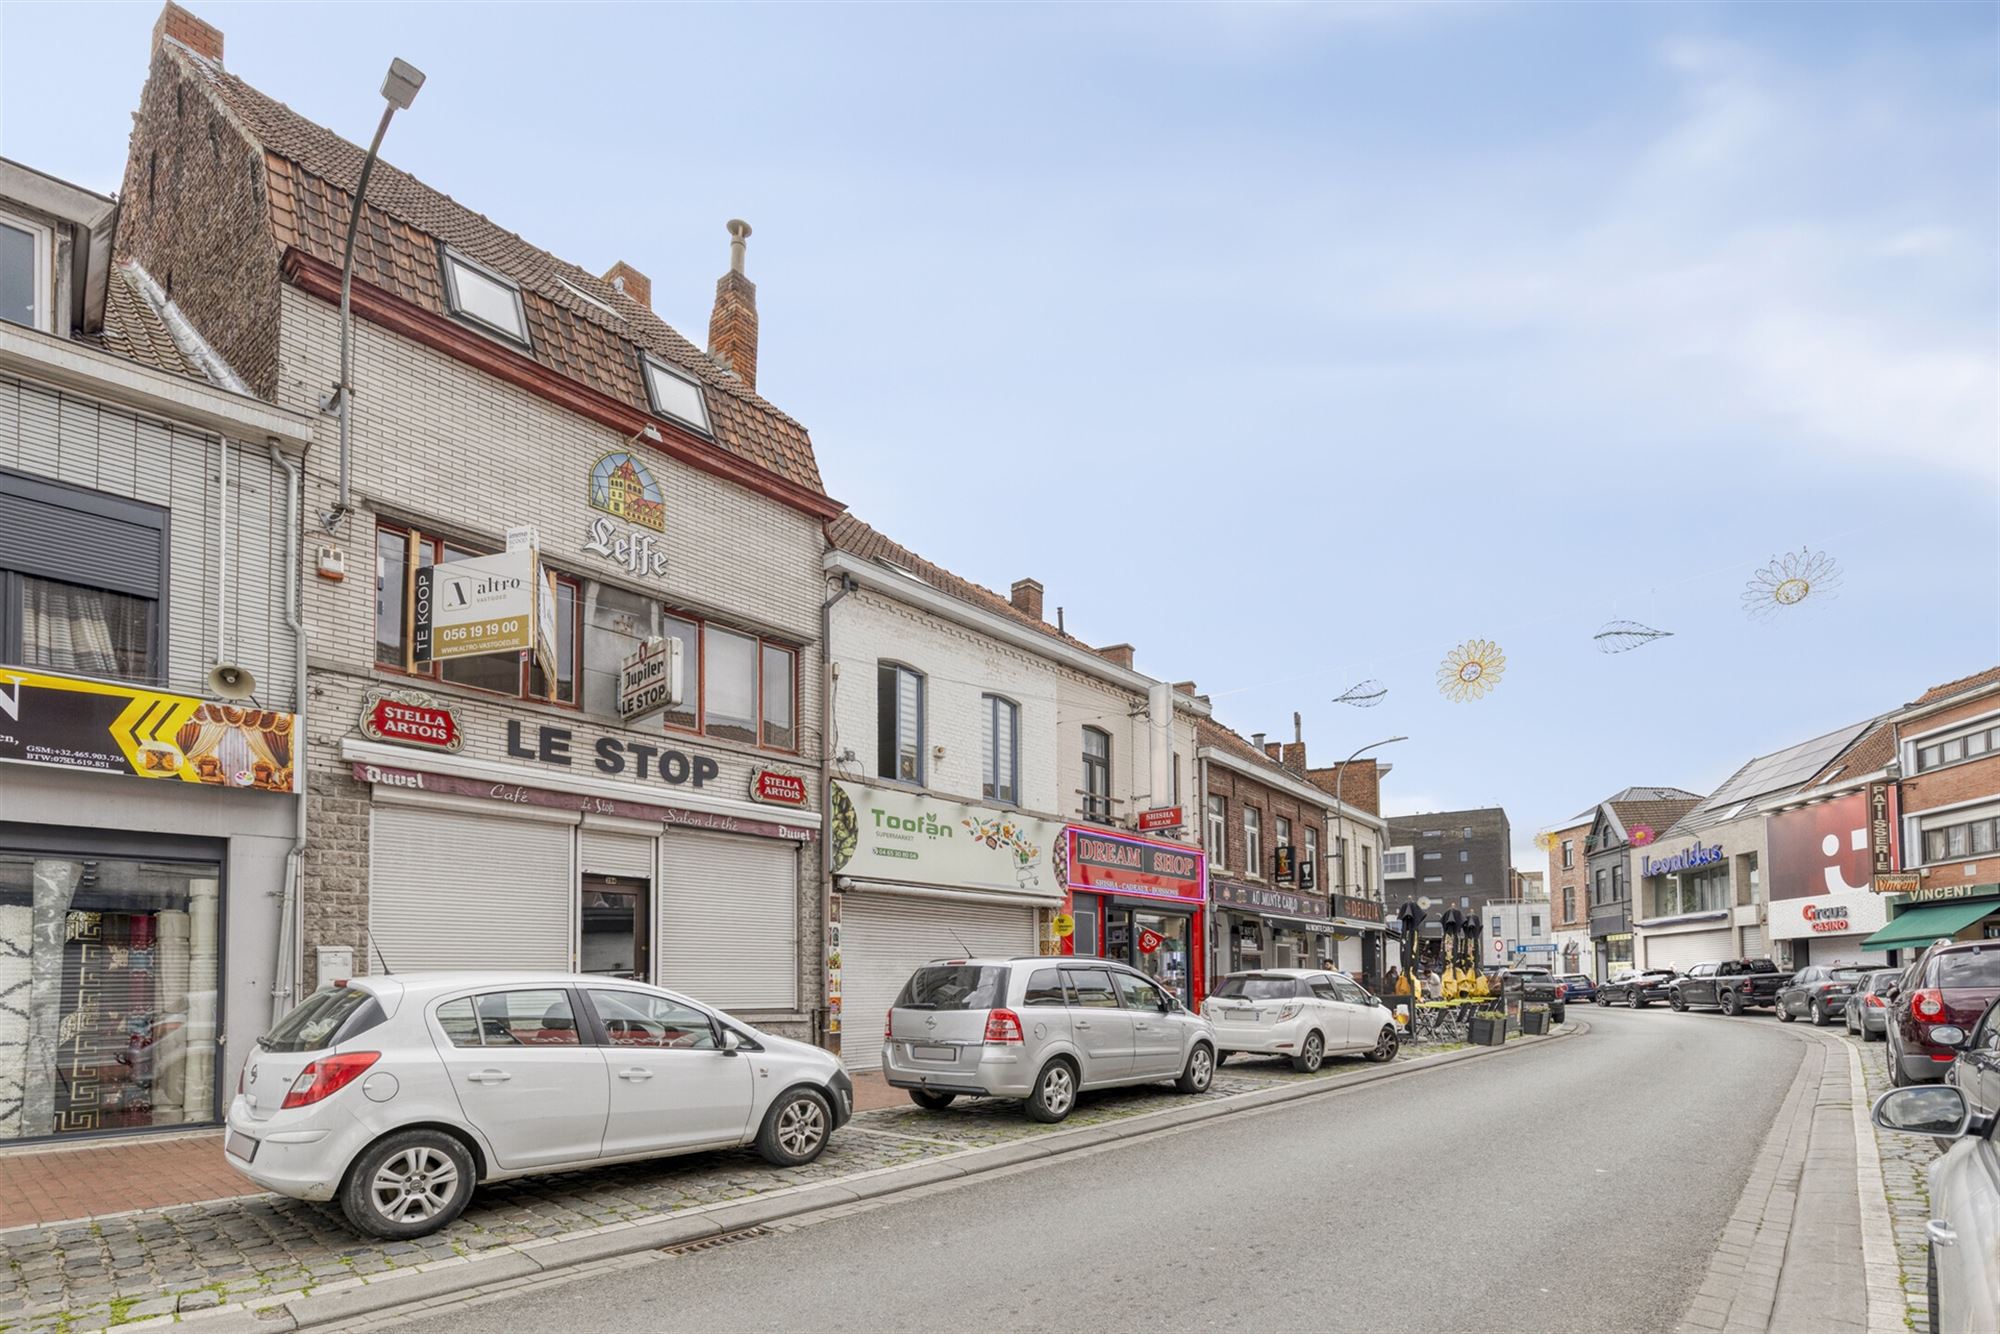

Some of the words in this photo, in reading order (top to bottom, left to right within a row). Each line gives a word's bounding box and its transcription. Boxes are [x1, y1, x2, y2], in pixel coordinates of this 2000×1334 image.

[583, 518, 668, 577] Leffe
[477, 577, 521, 594] altro
[416, 575, 430, 624] KOOP
[416, 626, 428, 653] TE
[443, 627, 467, 641] 056
[470, 625, 483, 638] 19
[486, 623, 499, 635] 19
[501, 620, 519, 633] 00
[624, 660, 664, 690] Jupiler
[622, 697, 634, 715] LE
[637, 684, 666, 709] STOP
[384, 706, 447, 727] STELLA
[384, 720, 448, 740] ARTOIS
[507, 719, 572, 766] LE
[594, 736, 720, 788] STOP
[365, 765, 424, 788] Duvel
[764, 775, 800, 790] STELLA
[489, 784, 529, 803] Café
[764, 786, 801, 800] ARTOIS
[580, 797, 592, 810] Le
[595, 798, 616, 815] Stop
[1146, 810, 1175, 820] SHISHA
[661, 808, 702, 825] Salon
[704, 814, 718, 827] de
[721, 817, 739, 831] thé
[1149, 819, 1171, 827] DREAM
[1872, 785, 1888, 871] PATISSERIE
[778, 825, 811, 841] Duvel
[1080, 838, 1142, 868] DREAM
[1153, 852, 1195, 876] SHOP
[1641, 841, 1724, 878] Leonidas
[1876, 880, 1919, 892] Vincent
[1909, 884, 1976, 902] VINCENT
